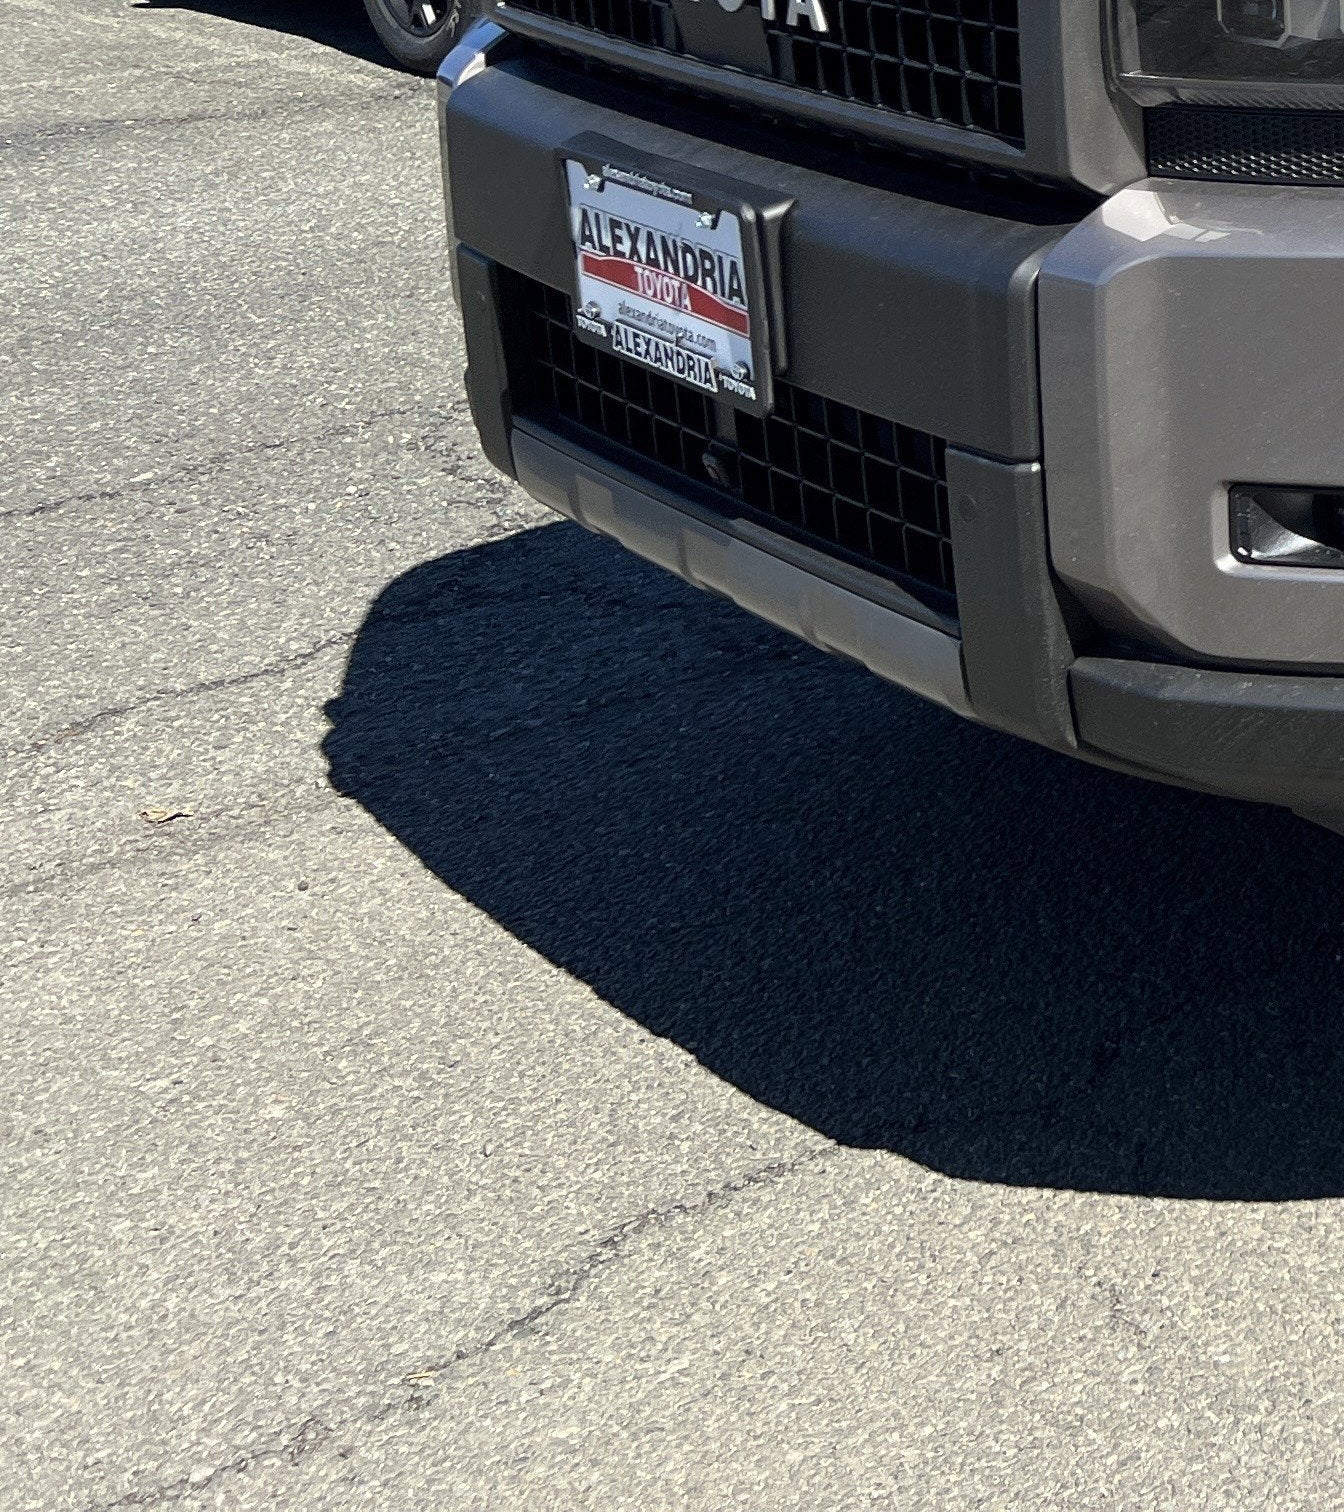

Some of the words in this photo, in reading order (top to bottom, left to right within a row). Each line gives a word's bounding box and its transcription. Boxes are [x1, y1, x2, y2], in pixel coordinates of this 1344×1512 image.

[580, 207, 747, 307] ALEXANDRIA
[634, 266, 692, 310] TOYOTA
[577, 314, 607, 337] TOYOTA
[613, 323, 717, 390] ALEXANDRIA
[720, 374, 757, 400] TOYOTA
